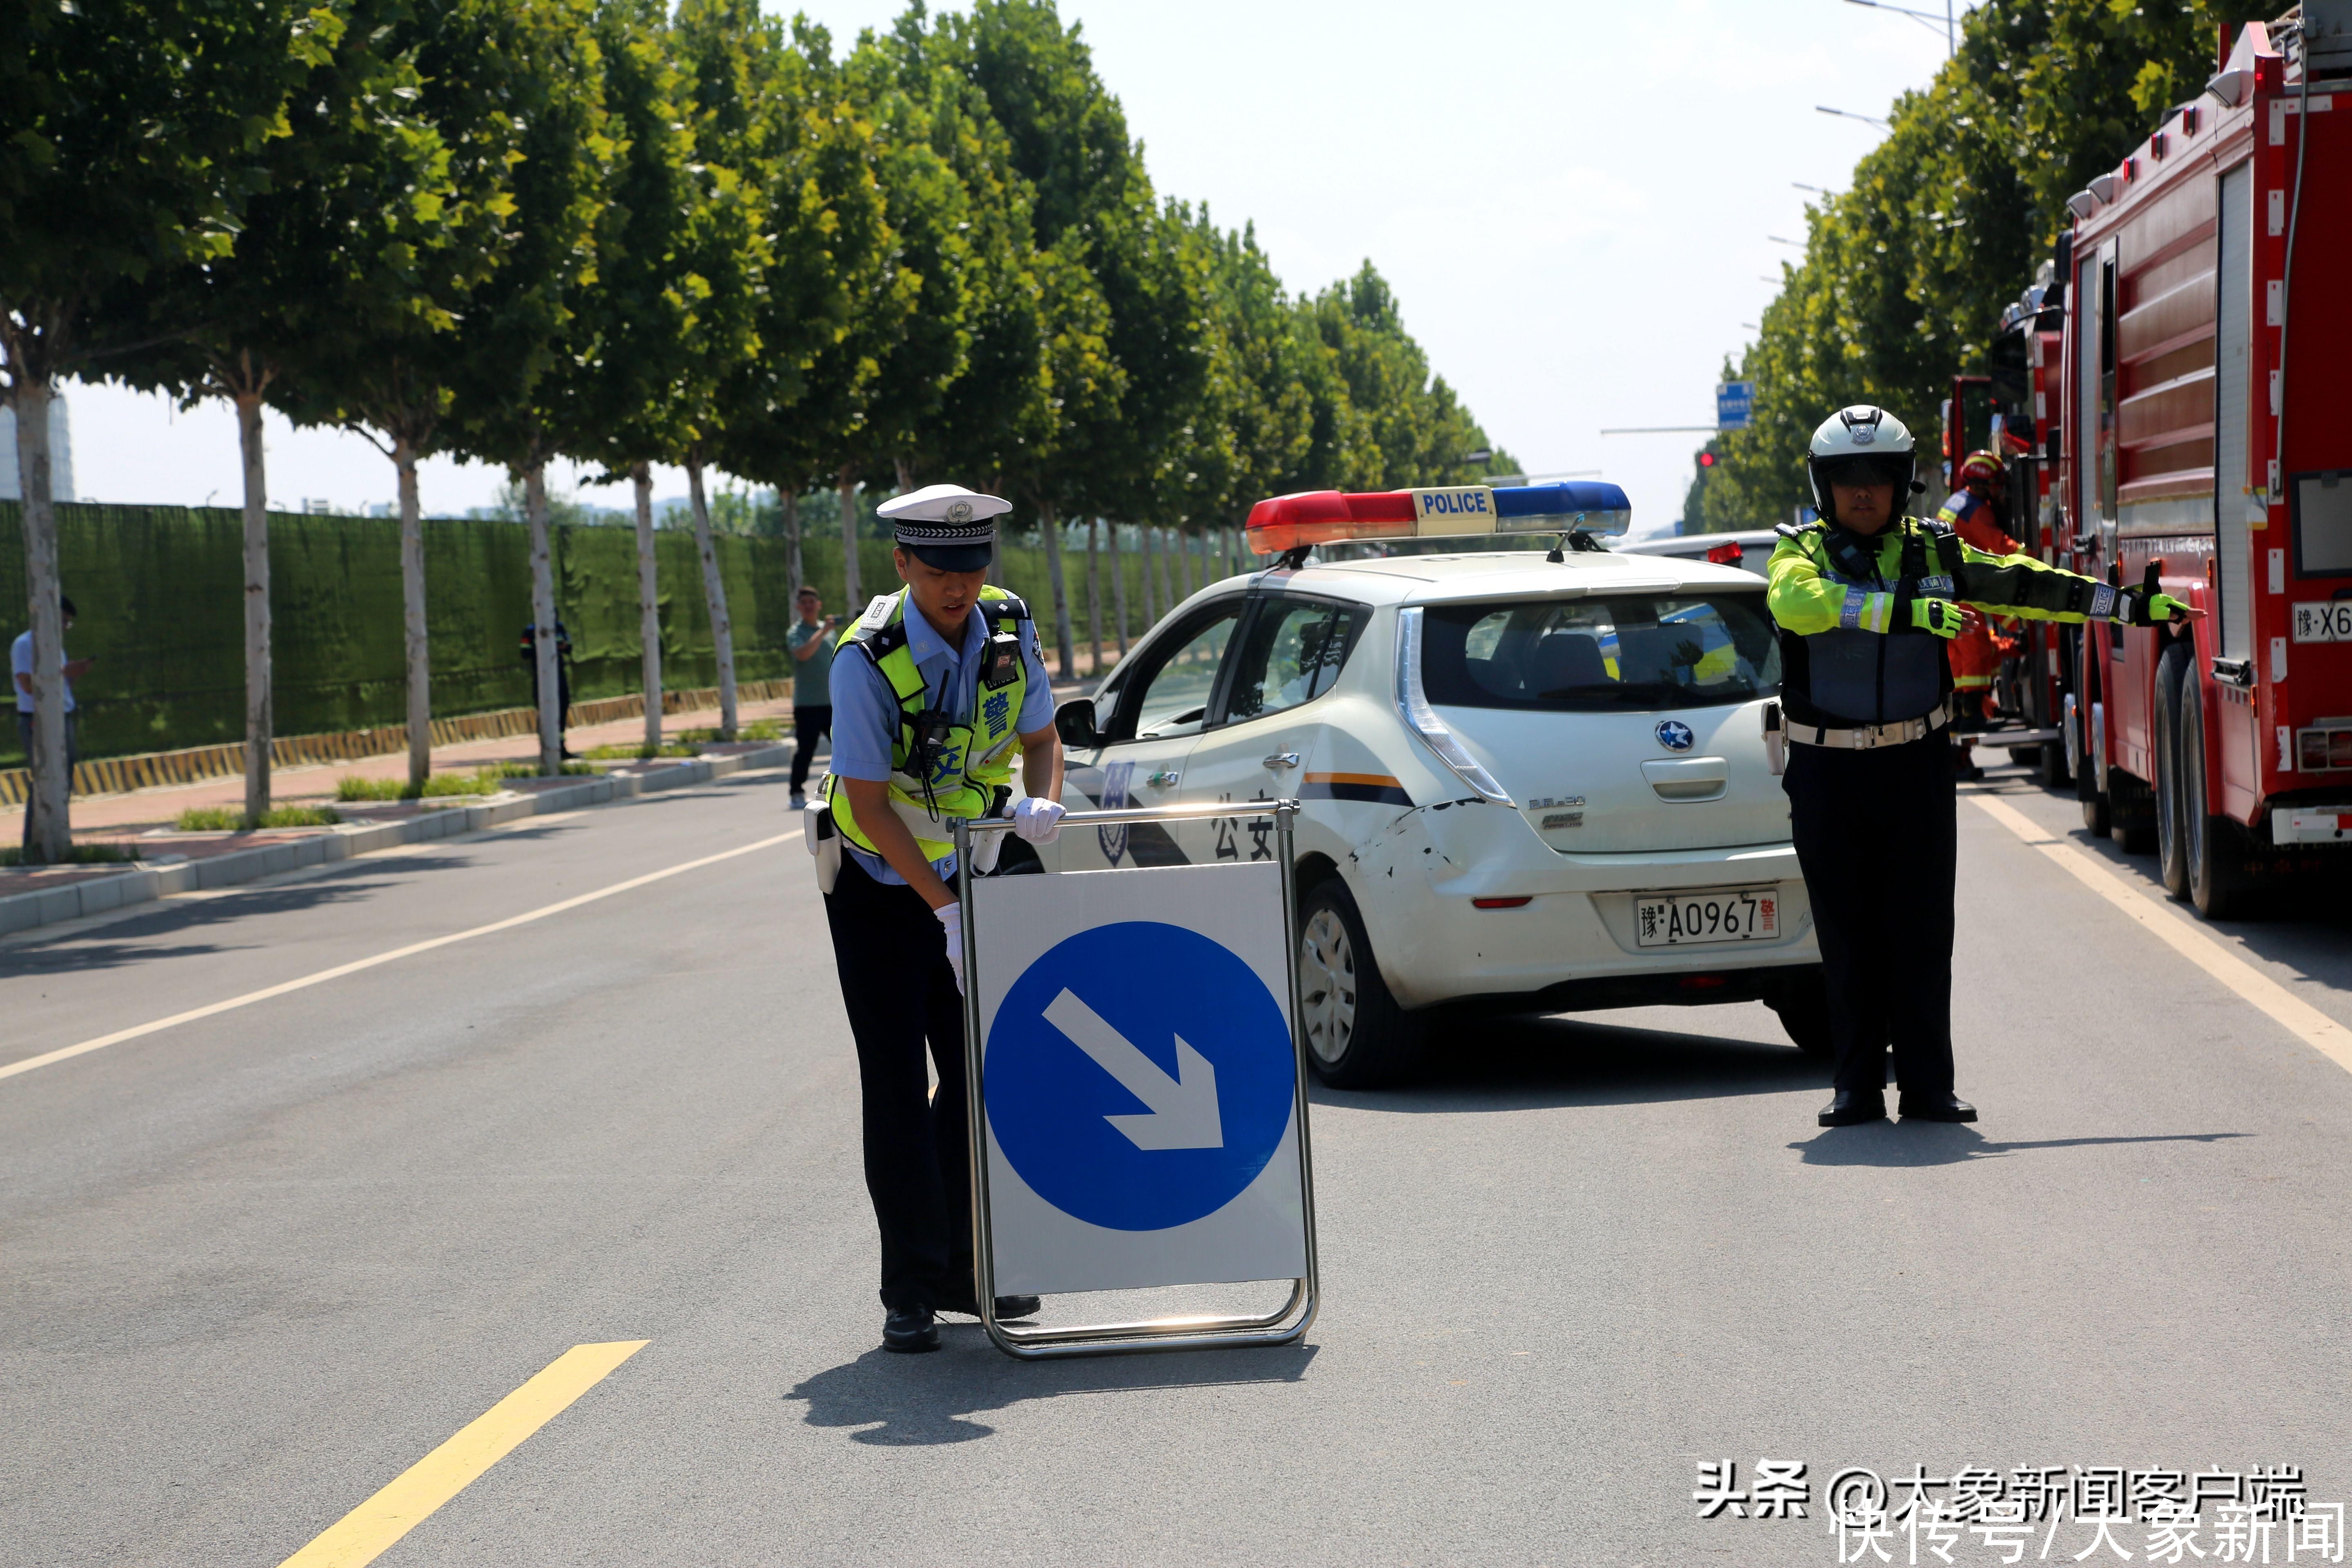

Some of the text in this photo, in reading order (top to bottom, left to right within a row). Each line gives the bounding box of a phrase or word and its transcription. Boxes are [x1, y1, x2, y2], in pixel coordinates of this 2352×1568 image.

[1423, 492, 1487, 514] POLICE
[873, 604, 884, 617] POLICE
[2097, 588, 2109, 615] POLICE
[930, 691, 1010, 785] 交 警
[1211, 788, 1274, 862] 公安
